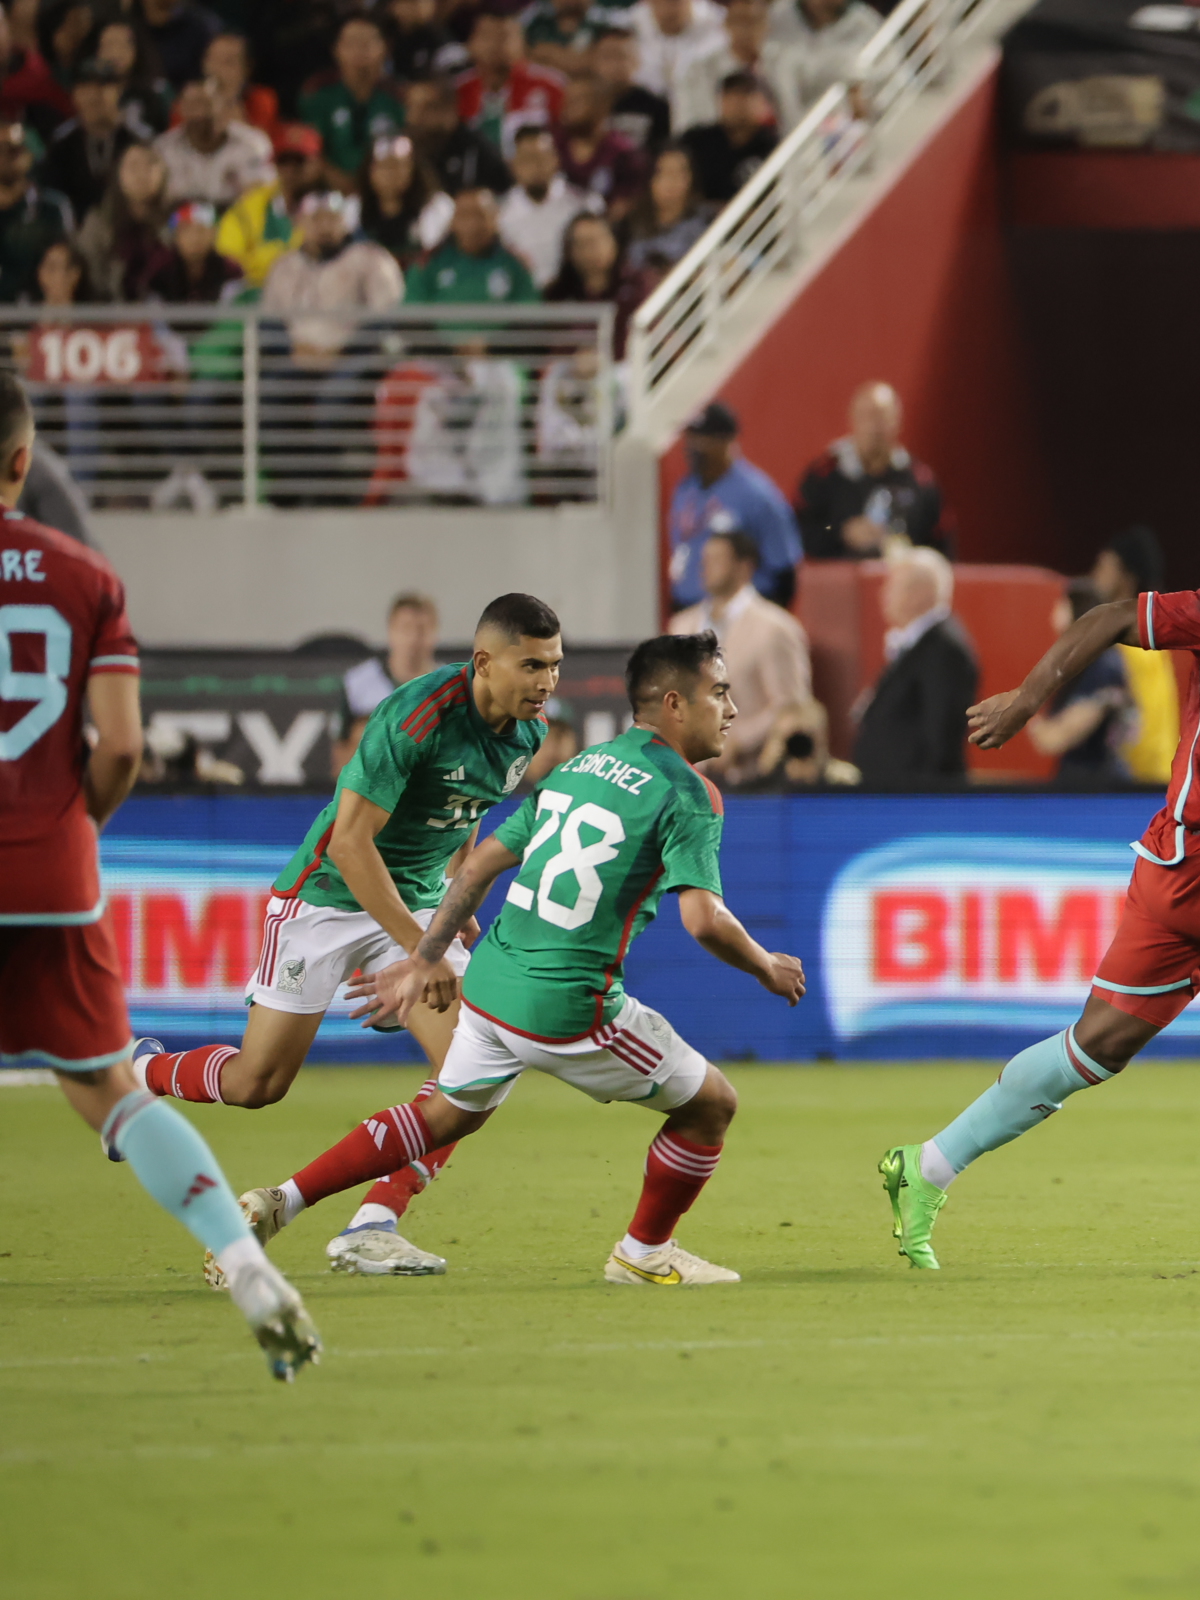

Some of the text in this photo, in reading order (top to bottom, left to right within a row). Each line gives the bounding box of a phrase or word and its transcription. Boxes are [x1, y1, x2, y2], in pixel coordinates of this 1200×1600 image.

[38, 328, 142, 384] 106
[0, 549, 46, 583] RE
[0, 603, 72, 762] 9
[506, 788, 626, 930] 28
